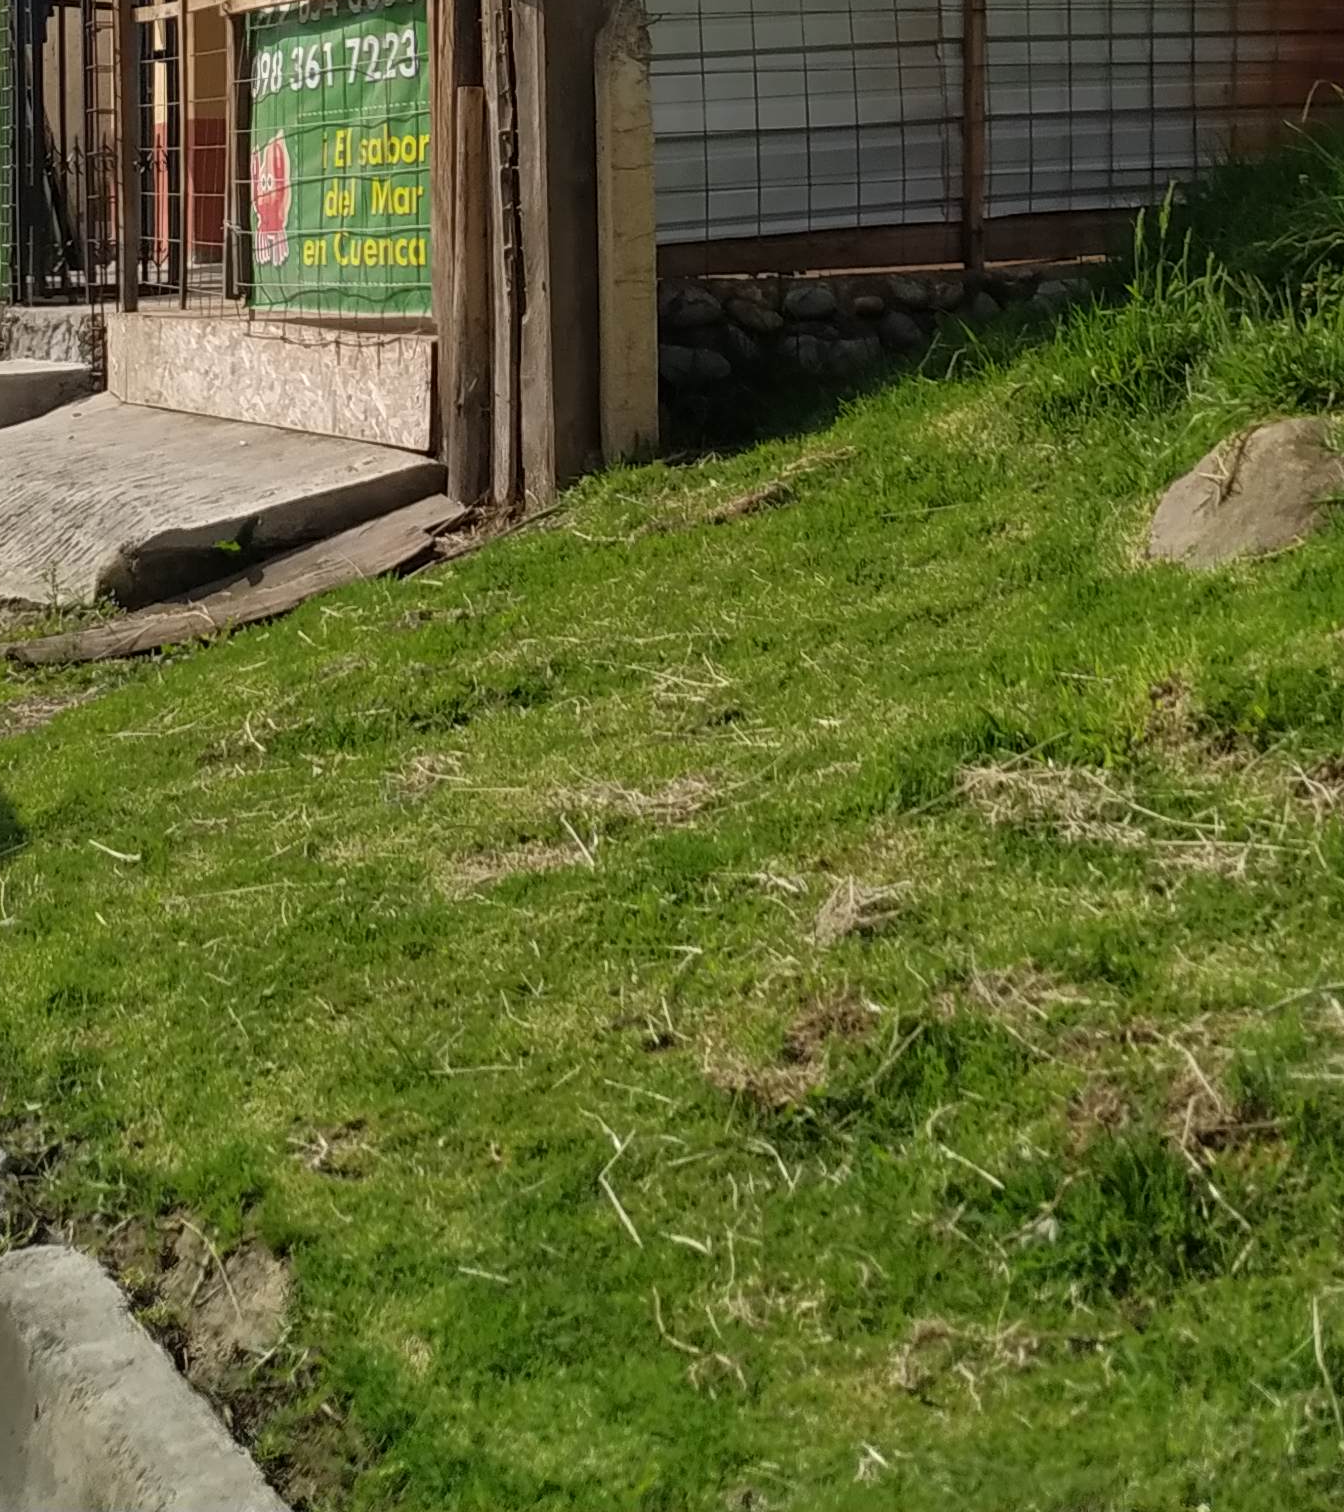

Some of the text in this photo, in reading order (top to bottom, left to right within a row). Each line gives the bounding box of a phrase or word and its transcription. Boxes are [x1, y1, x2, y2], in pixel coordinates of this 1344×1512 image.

[289, 42, 335, 91] 361
[344, 28, 420, 84] 7223
[334, 127, 353, 168] El
[358, 122, 430, 167] sabor
[325, 176, 424, 218] del Mar
[303, 231, 427, 267] en Cuenca
